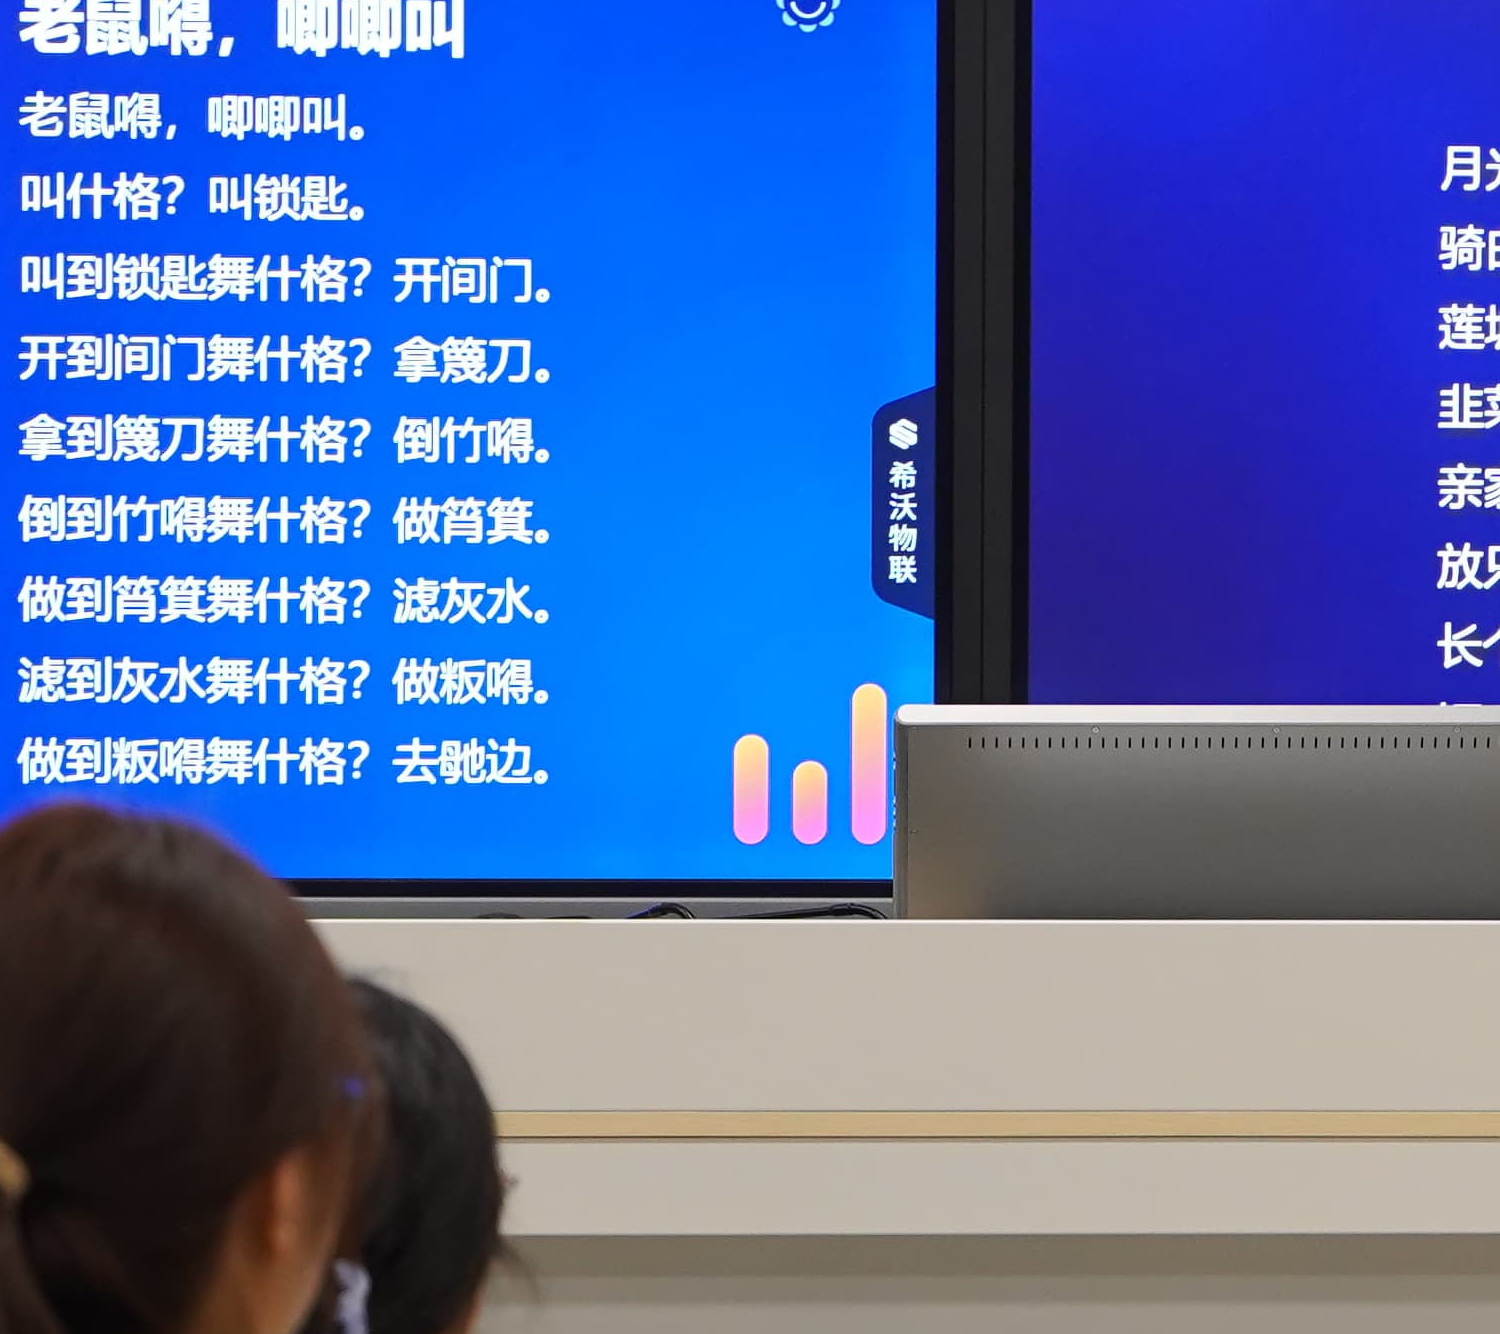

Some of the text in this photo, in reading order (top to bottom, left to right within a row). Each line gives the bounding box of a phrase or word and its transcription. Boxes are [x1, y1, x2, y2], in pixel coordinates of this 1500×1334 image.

[21, 171, 365, 222] 叫什格？叫锁匙。
[21, 252, 550, 304] 叫到锁匙舞什格？开间门。
[888, 460, 918, 584] 希沃物联
